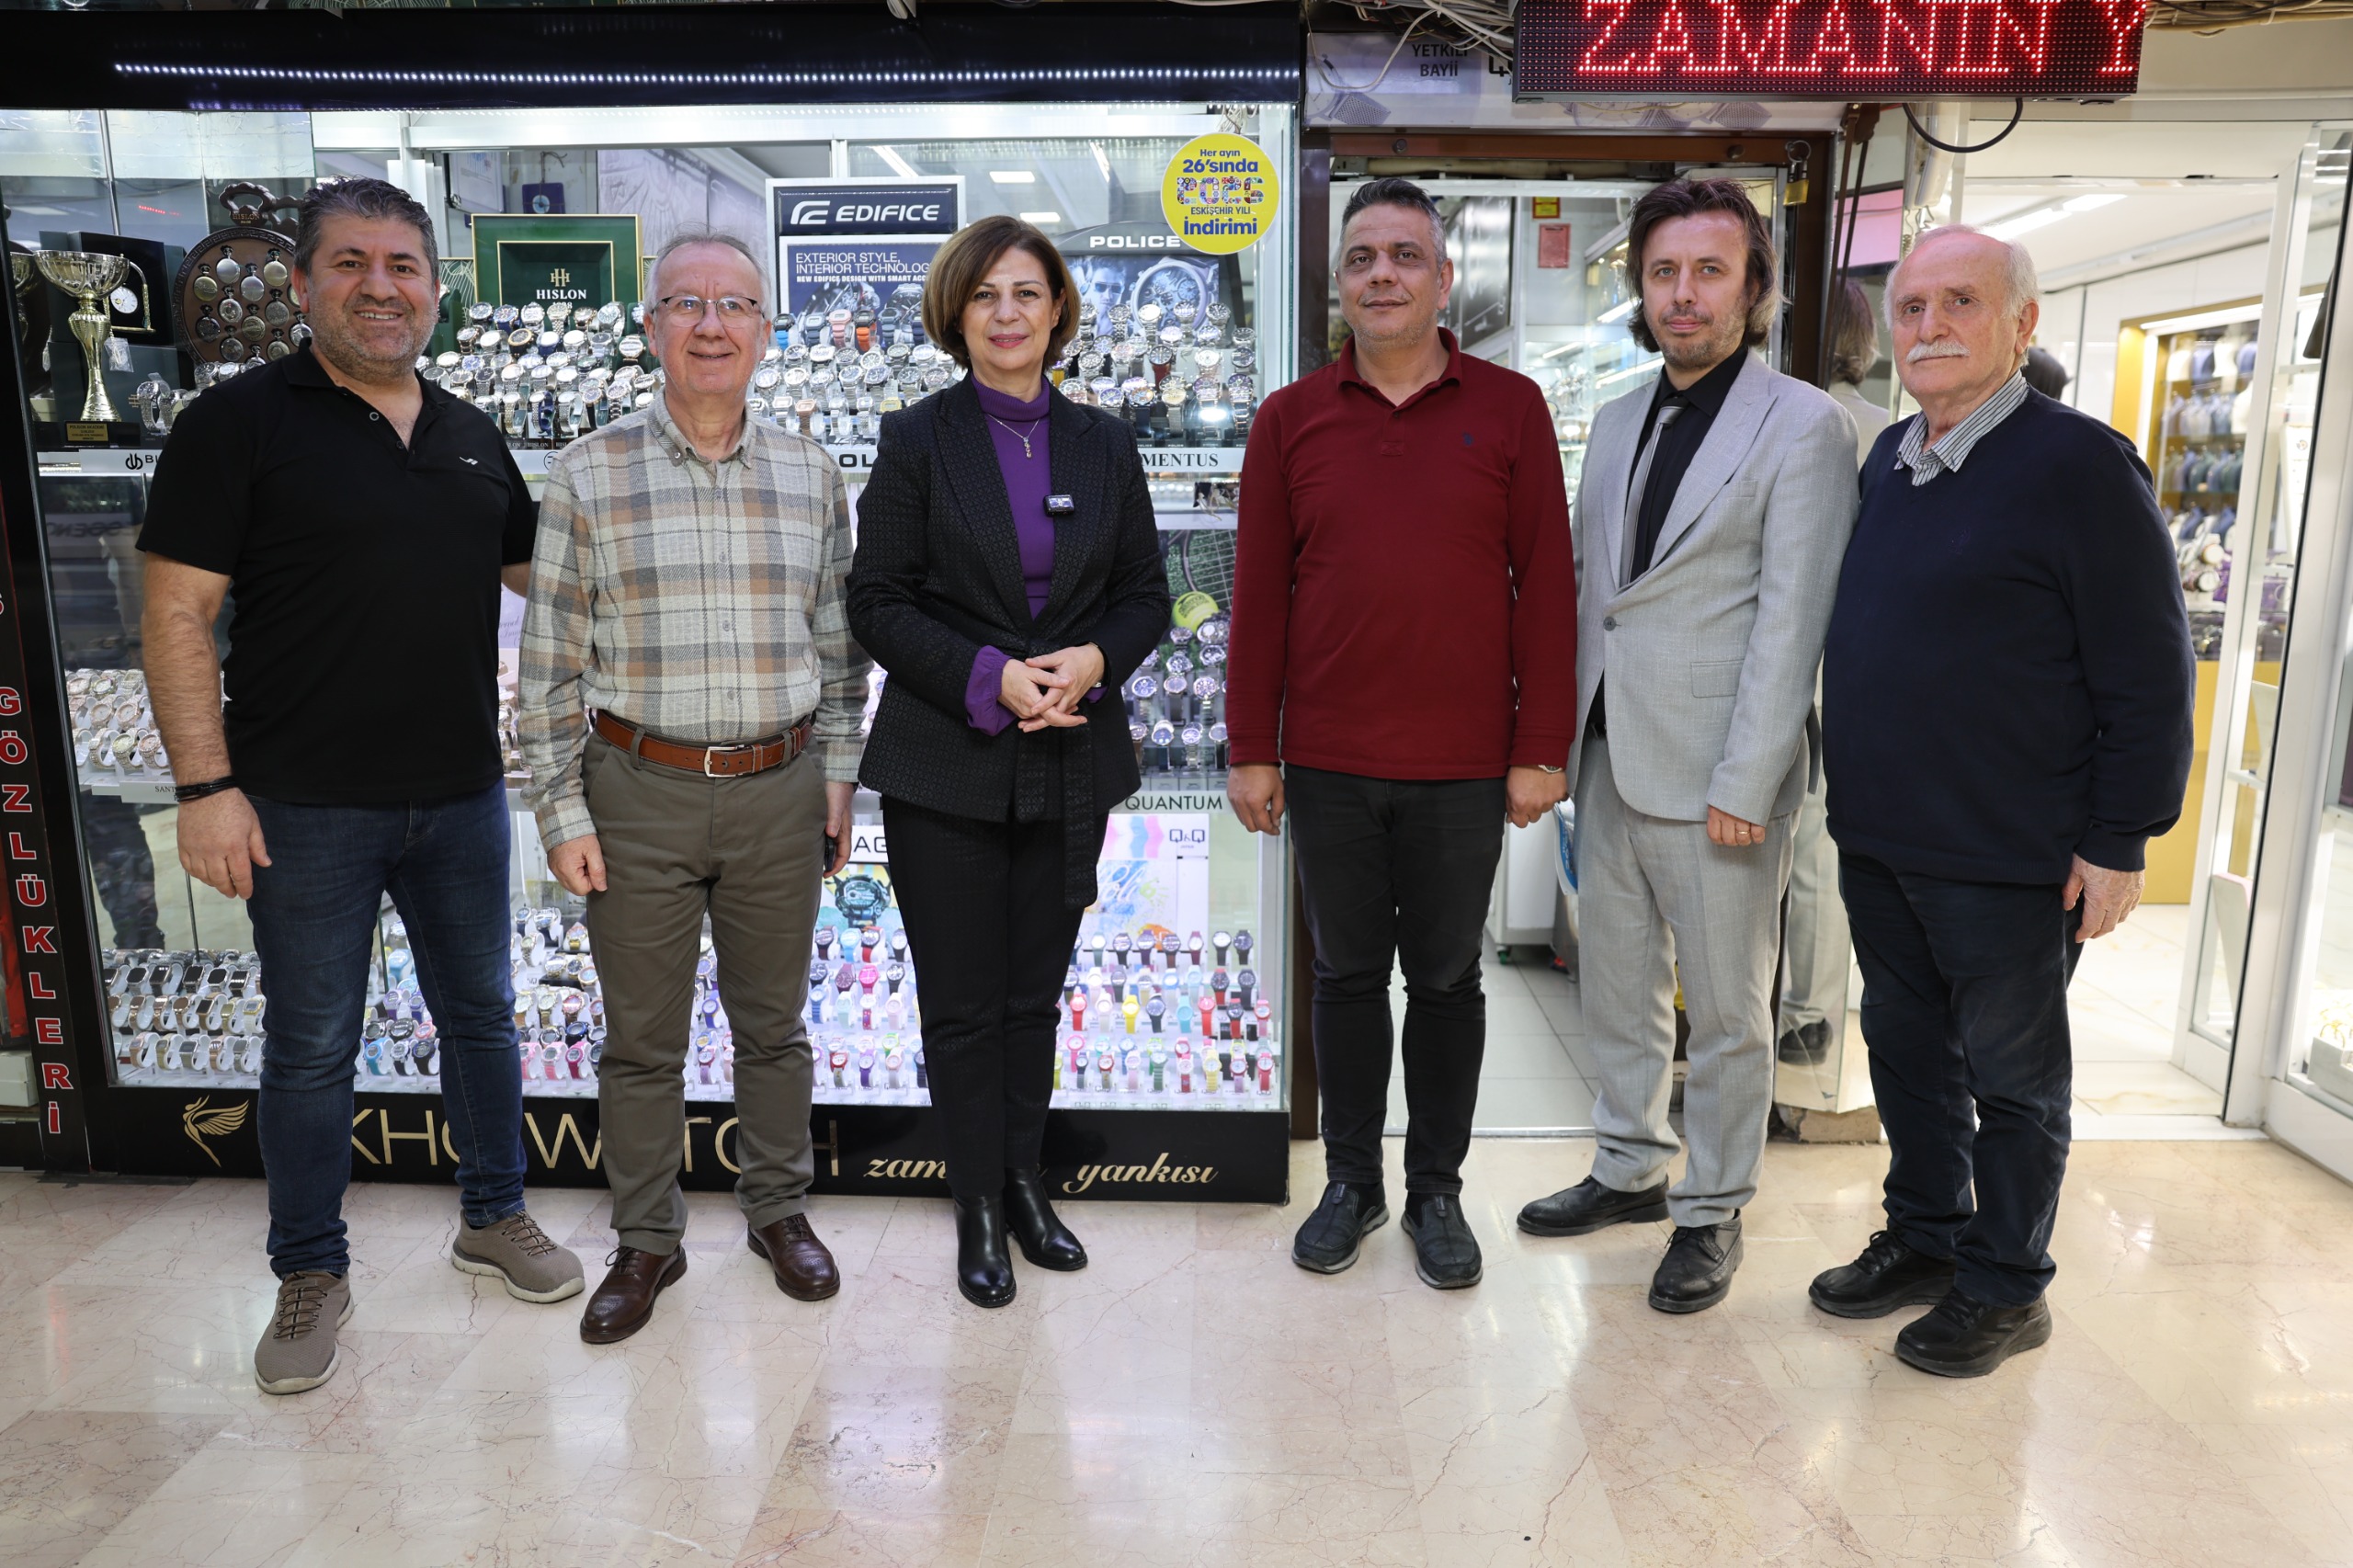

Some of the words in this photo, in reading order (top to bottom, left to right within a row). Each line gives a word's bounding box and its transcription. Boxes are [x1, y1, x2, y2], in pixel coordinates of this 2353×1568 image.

[1578, 0, 2060, 72] ZAMANIN
[2097, 0, 2147, 72] Y
[1420, 61, 1459, 77] BAYİİ
[1199, 149, 1217, 157] Her
[1219, 150, 1241, 158] ayın
[835, 204, 940, 222] EDIFICE
[1184, 216, 1257, 234] İndirimi
[1089, 235, 1181, 248] POLICE
[795, 253, 856, 264] EXTERIOR
[859, 252, 901, 264] STYLE,
[796, 263, 852, 274] INTERIOR
[855, 262, 931, 274] TECHNOLOG
[536, 290, 586, 300] HISLON
[1142, 453, 1219, 467] MENTUS
[154, 785, 176, 793] SANT
[1125, 796, 1222, 810] QUANTUM
[1169, 829, 1205, 843] Q&Q
[1062, 1152, 1220, 1194] yankısı
